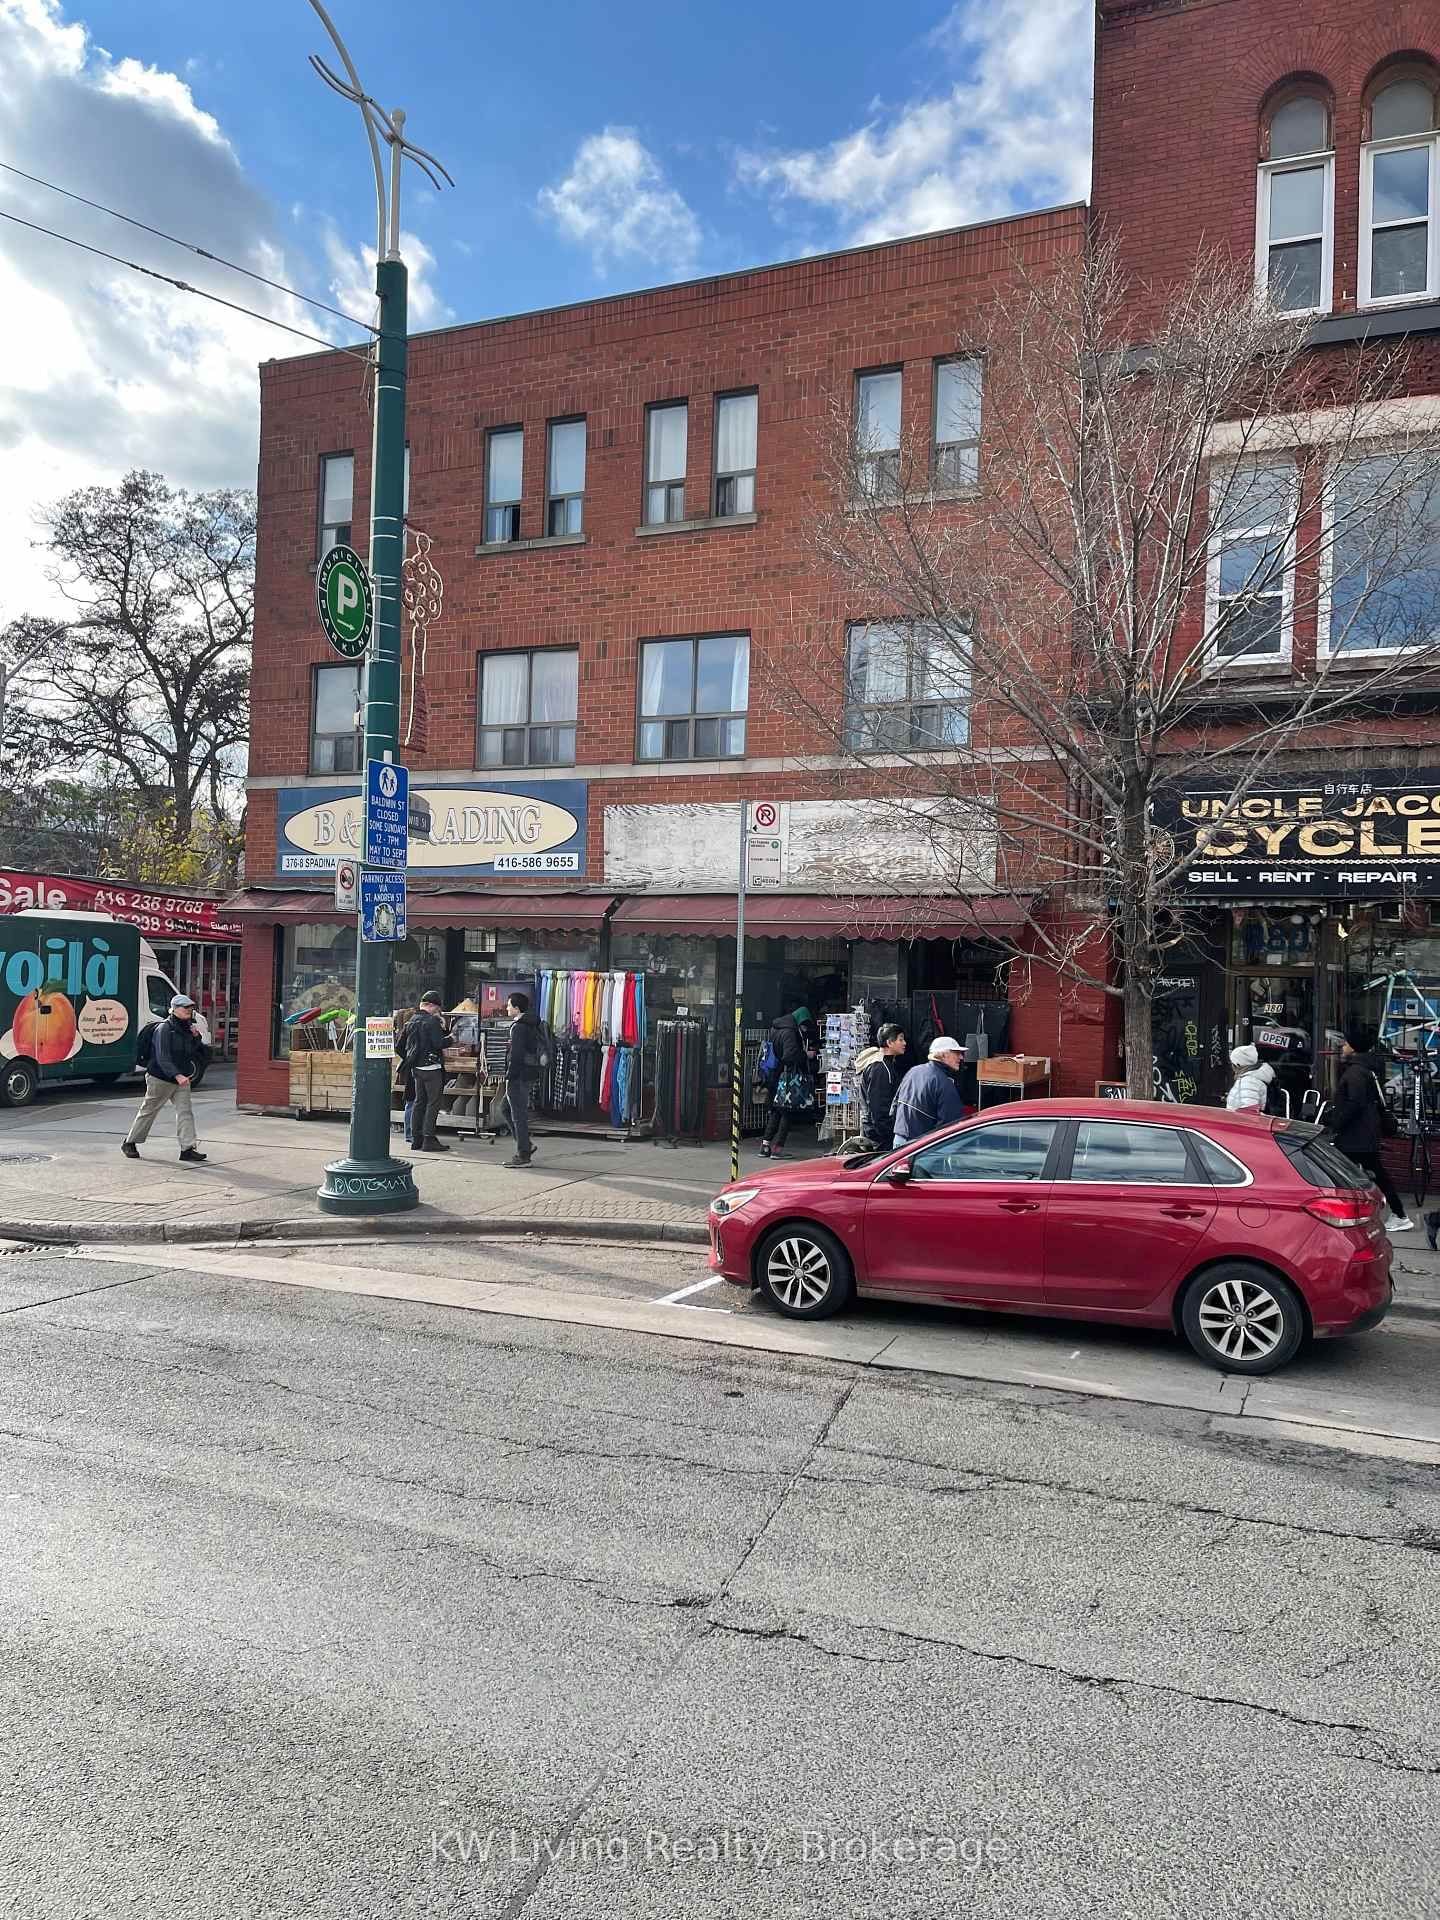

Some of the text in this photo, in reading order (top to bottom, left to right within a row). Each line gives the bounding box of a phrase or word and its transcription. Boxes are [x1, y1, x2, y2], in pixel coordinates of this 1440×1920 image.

[321, 550, 371, 609] MUNICIPAL
[337, 572, 358, 615] P
[320, 599, 370, 653] PARKING
[1324, 783, 1373, 795] 自行车店
[371, 794, 405, 811] BALDWIN ST
[1182, 797, 1323, 818] UNCLE
[376, 809, 399, 822] CLOSED
[313, 810, 336, 847] B
[369, 819, 407, 836] SOME SUNDAYS
[376, 833, 382, 844] 12
[388, 835, 399, 846] 7PM
[369, 845, 406, 859] MAY TO SEPT
[285, 858, 336, 868] 376-8 SPADINA
[498, 856, 574, 869] 416-586 9655
[361, 874, 405, 884] PARKING ACCESS
[1188, 871, 1239, 883] SELL
[1259, 871, 1315, 883] RENT
[1337, 871, 1417, 883] REPAIR
[379, 884, 388, 892] VIA
[0, 878, 67, 910] Sale
[95, 889, 127, 907] 416
[131, 894, 161, 910] 238
[165, 898, 205, 914] 9768
[373, 893, 395, 902] ANDREW
[396, 893, 403, 902] ST
[1263, 1032, 1288, 1047] OPEN
